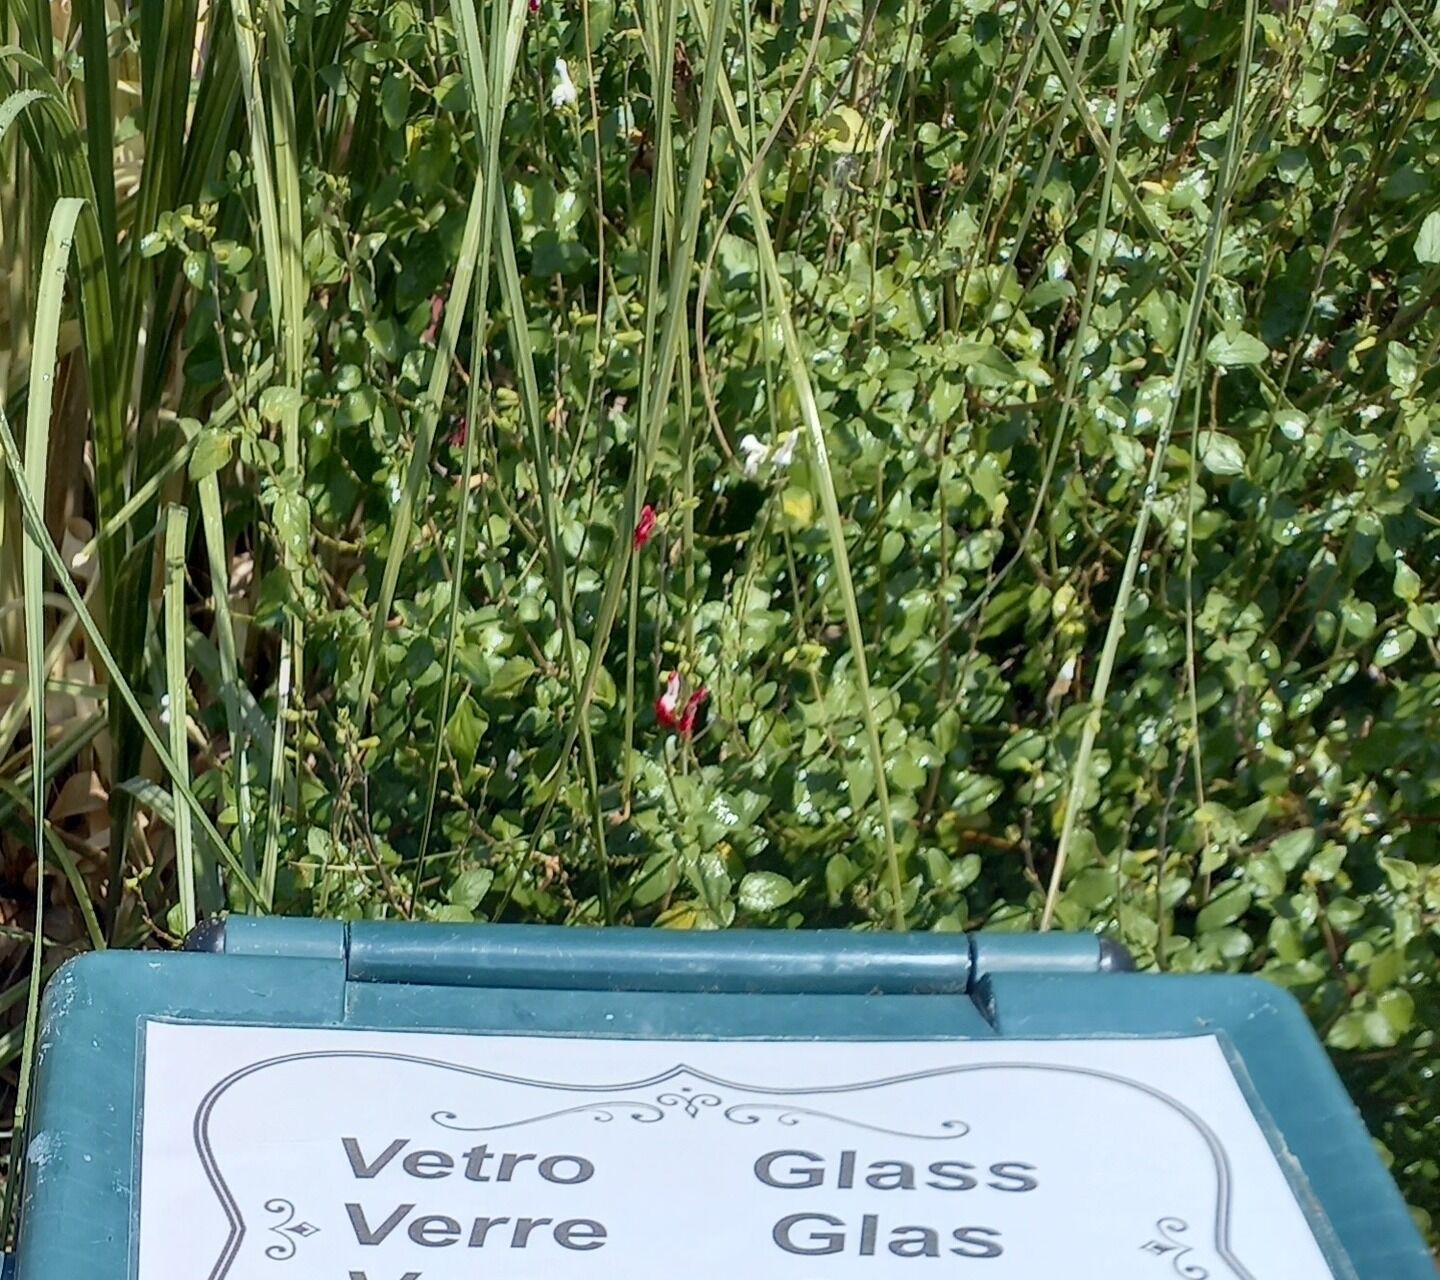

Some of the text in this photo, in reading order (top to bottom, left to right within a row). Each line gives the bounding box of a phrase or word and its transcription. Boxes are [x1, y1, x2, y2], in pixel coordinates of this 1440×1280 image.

[340, 1136, 596, 1184] Vetro
[753, 1149, 1040, 1192] Glass
[343, 1202, 607, 1251] Verre
[772, 1213, 1004, 1259] Glas
